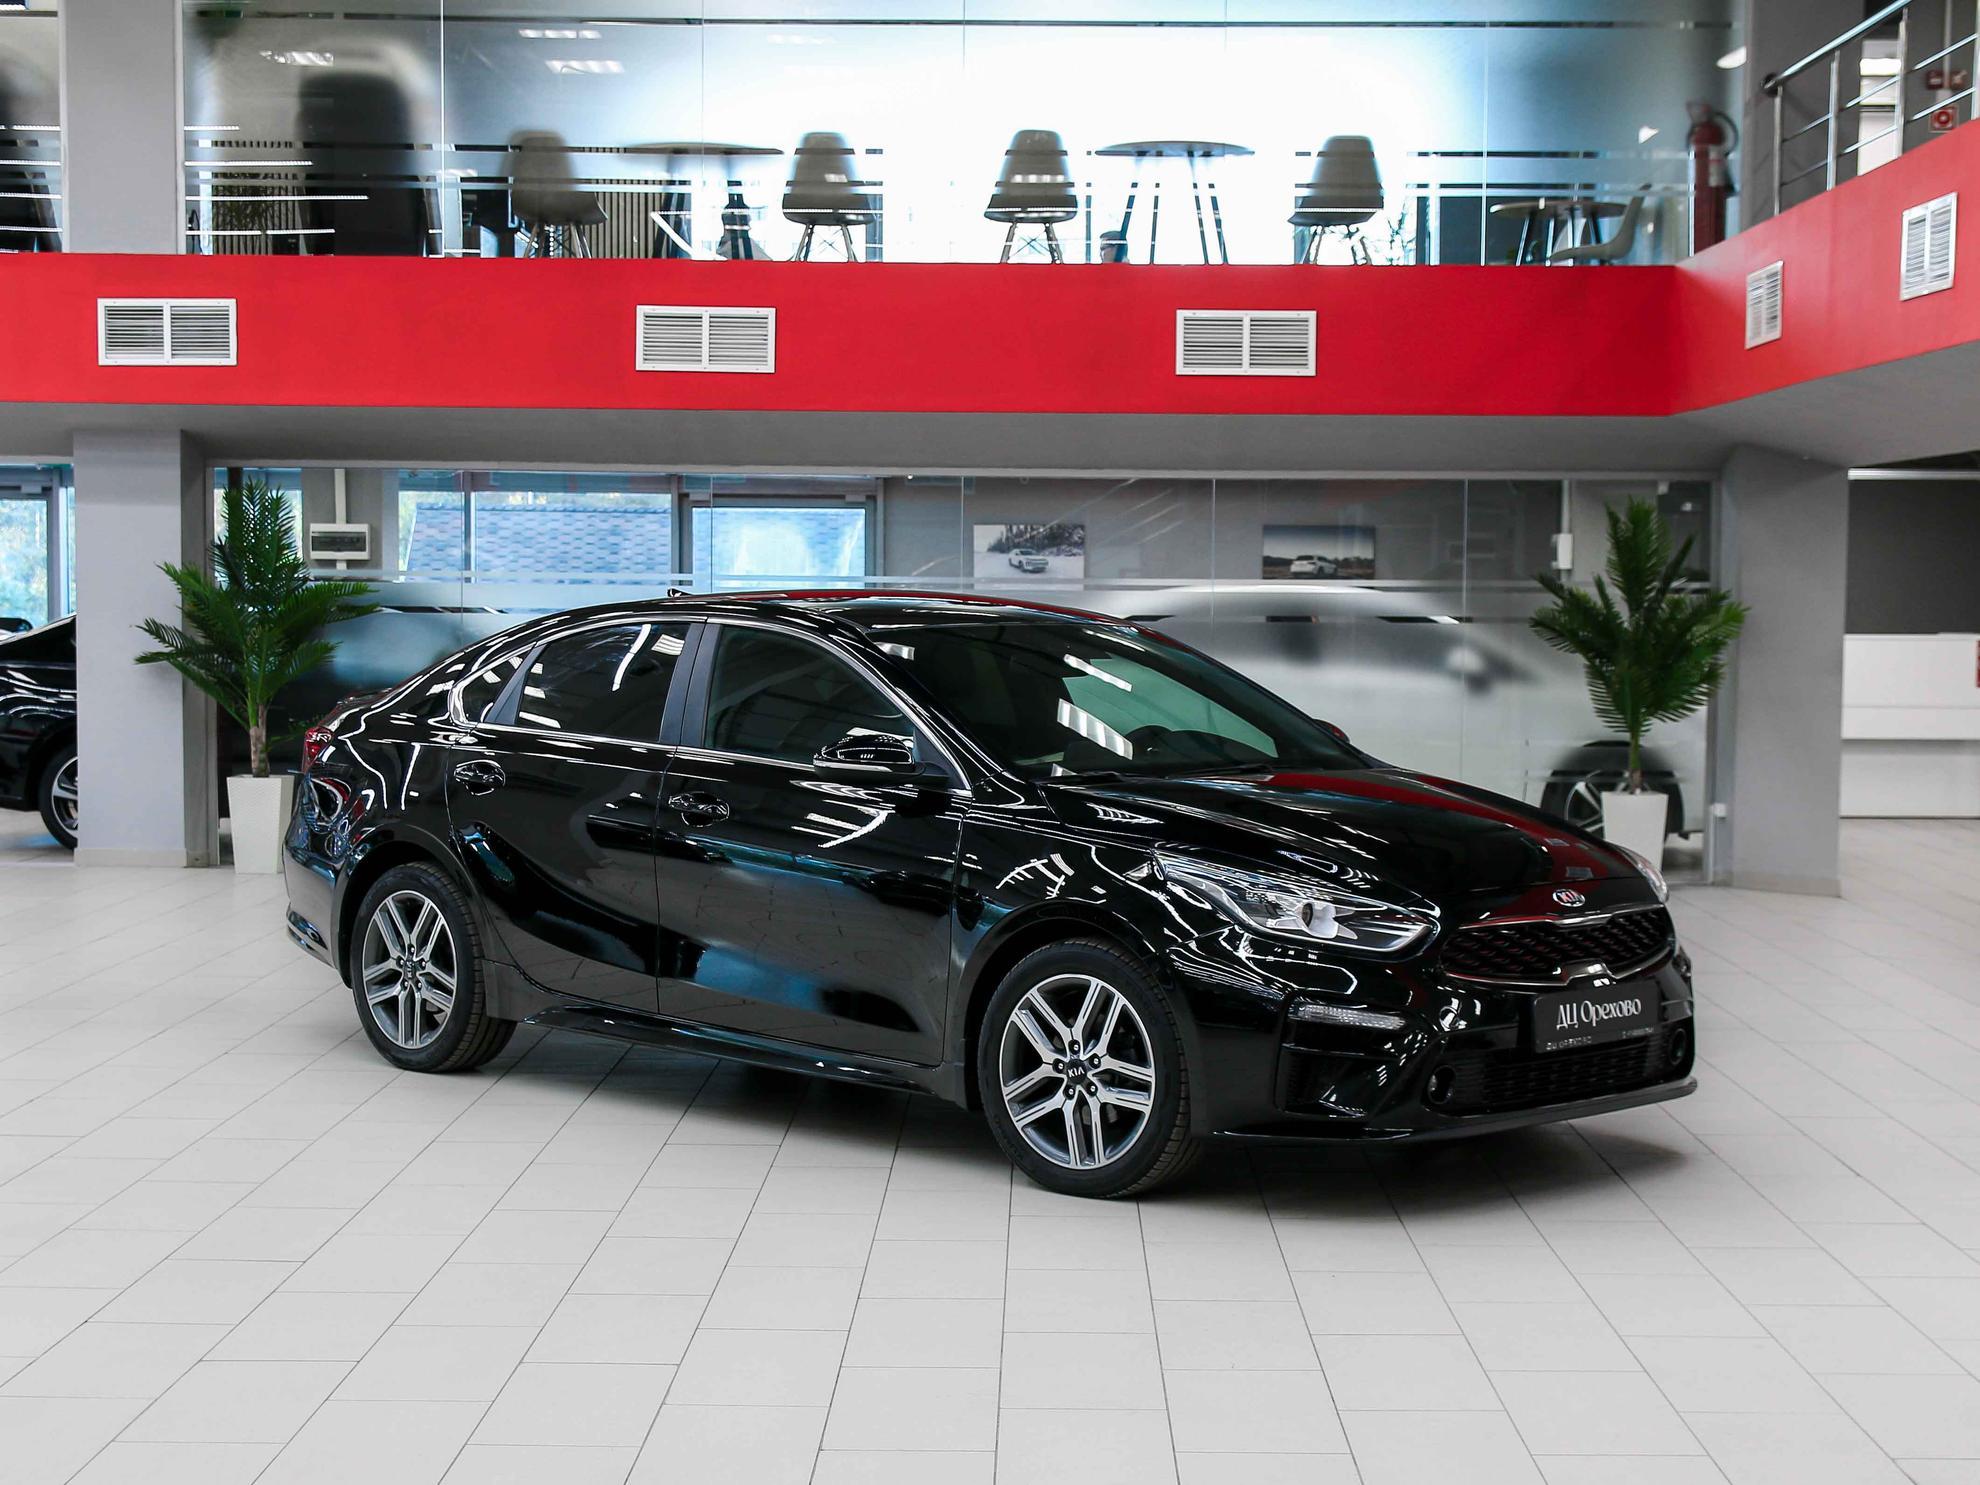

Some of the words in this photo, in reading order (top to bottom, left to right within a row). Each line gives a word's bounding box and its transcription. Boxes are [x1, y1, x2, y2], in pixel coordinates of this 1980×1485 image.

[1556, 1003, 1579, 1030] ДЦ
[1580, 998, 1642, 1027] Орехово
[1067, 1066, 1085, 1078] KIA
